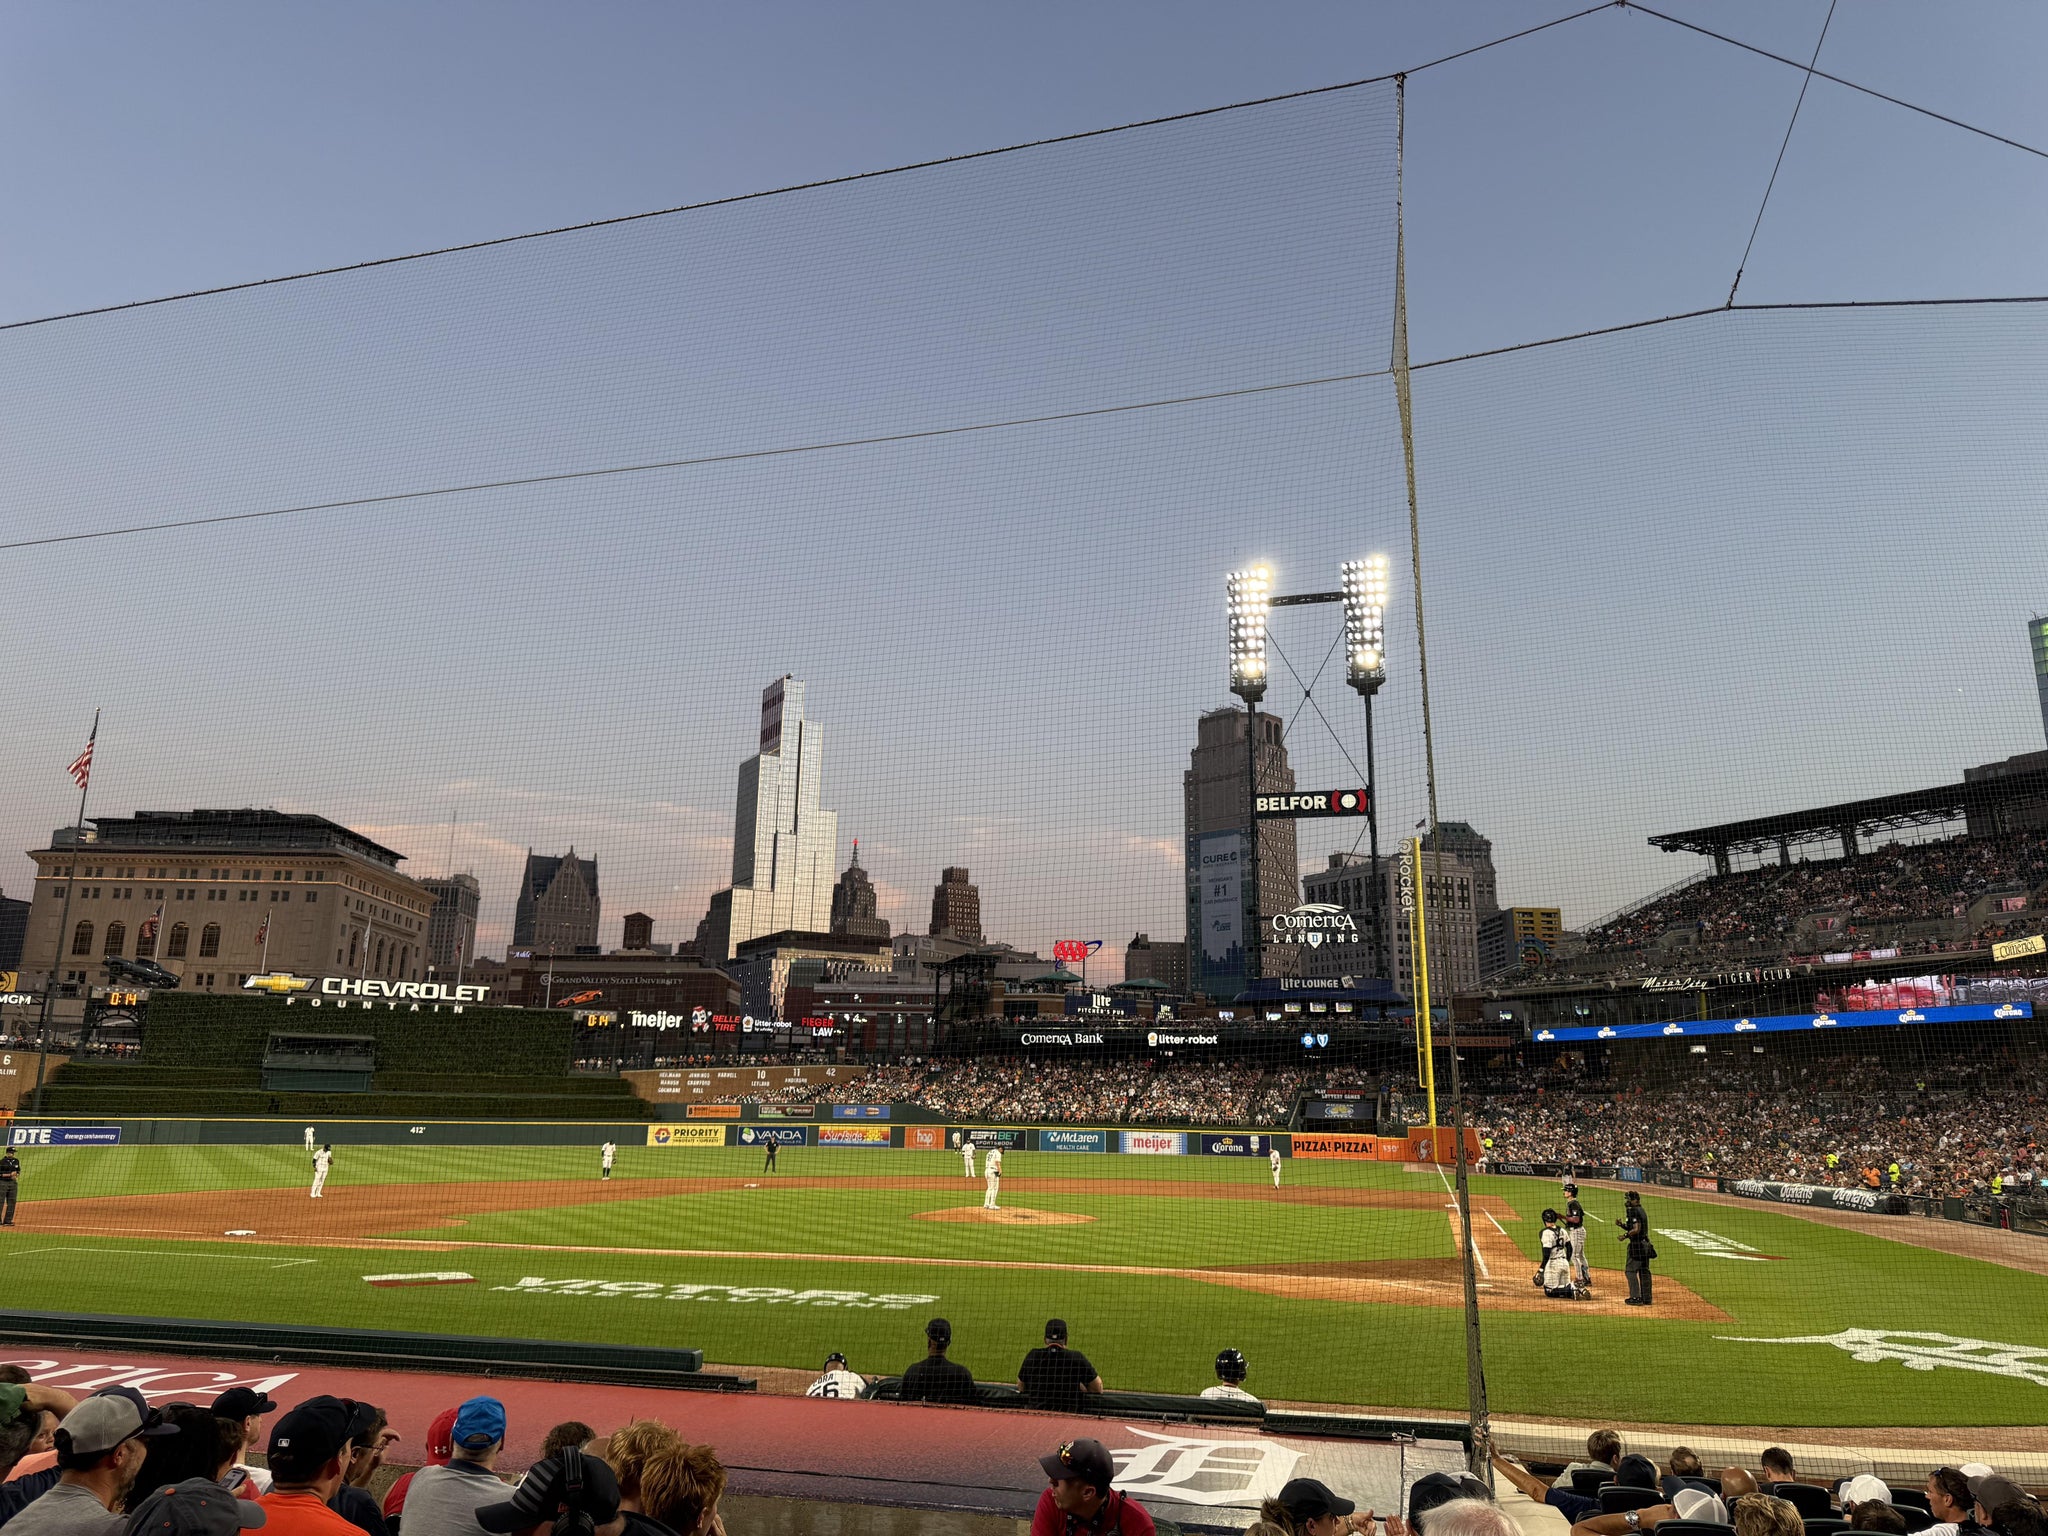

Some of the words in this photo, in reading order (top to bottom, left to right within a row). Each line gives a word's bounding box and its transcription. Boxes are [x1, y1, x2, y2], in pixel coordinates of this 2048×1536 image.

[1256, 795, 1327, 812] BELFOR
[1202, 853, 1229, 864] CURE
[1399, 854, 1416, 914] Rocket
[1214, 884, 1227, 897] #1
[1717, 971, 1752, 985] TIGER
[1762, 968, 1791, 981] CLUB
[321, 977, 491, 1001] CHEVROLET
[1280, 977, 1301, 991] Lite
[1302, 978, 1339, 989] LOUNGE
[1637, 976, 1682, 989] Motor
[1681, 977, 1716, 990] City
[109, 992, 137, 1006] 0:14
[286, 997, 464, 1013] FOUNTAIN
[1092, 993, 1112, 1009] Lite
[1077, 1007, 1111, 1015] PITCHER'S
[587, 1014, 609, 1027] 0:14
[631, 1010, 684, 1032] meijer
[712, 1015, 741, 1024] BELLE
[801, 1017, 835, 1027] FIEGER
[714, 1023, 737, 1032] TIRE
[812, 1027, 834, 1037] LAW
[1074, 1033, 1104, 1044] Bank
[3, 1054, 12, 1066] 6
[757, 1070, 766, 1079] 10
[793, 1068, 801, 1077] 11
[825, 1068, 836, 1077] 42
[12, 1128, 53, 1144] DTE
[410, 1126, 426, 1134] 412'
[673, 1128, 719, 1137] PRIORITY
[756, 1130, 803, 1140] VANDA
[824, 1129, 863, 1142] Surfside
[969, 1131, 997, 1140] ESPN
[997, 1131, 1019, 1141] BET
[1061, 1132, 1099, 1144] McLaren
[1133, 1135, 1173, 1152] meijer
[1211, 1142, 1244, 1154] Corona
[1293, 1141, 1332, 1153] PIZZA!
[1334, 1141, 1373, 1154] PIZZA!
[1835, 1201, 1867, 1210] SPORTS
[515, 1276, 941, 1304] VICTORS
